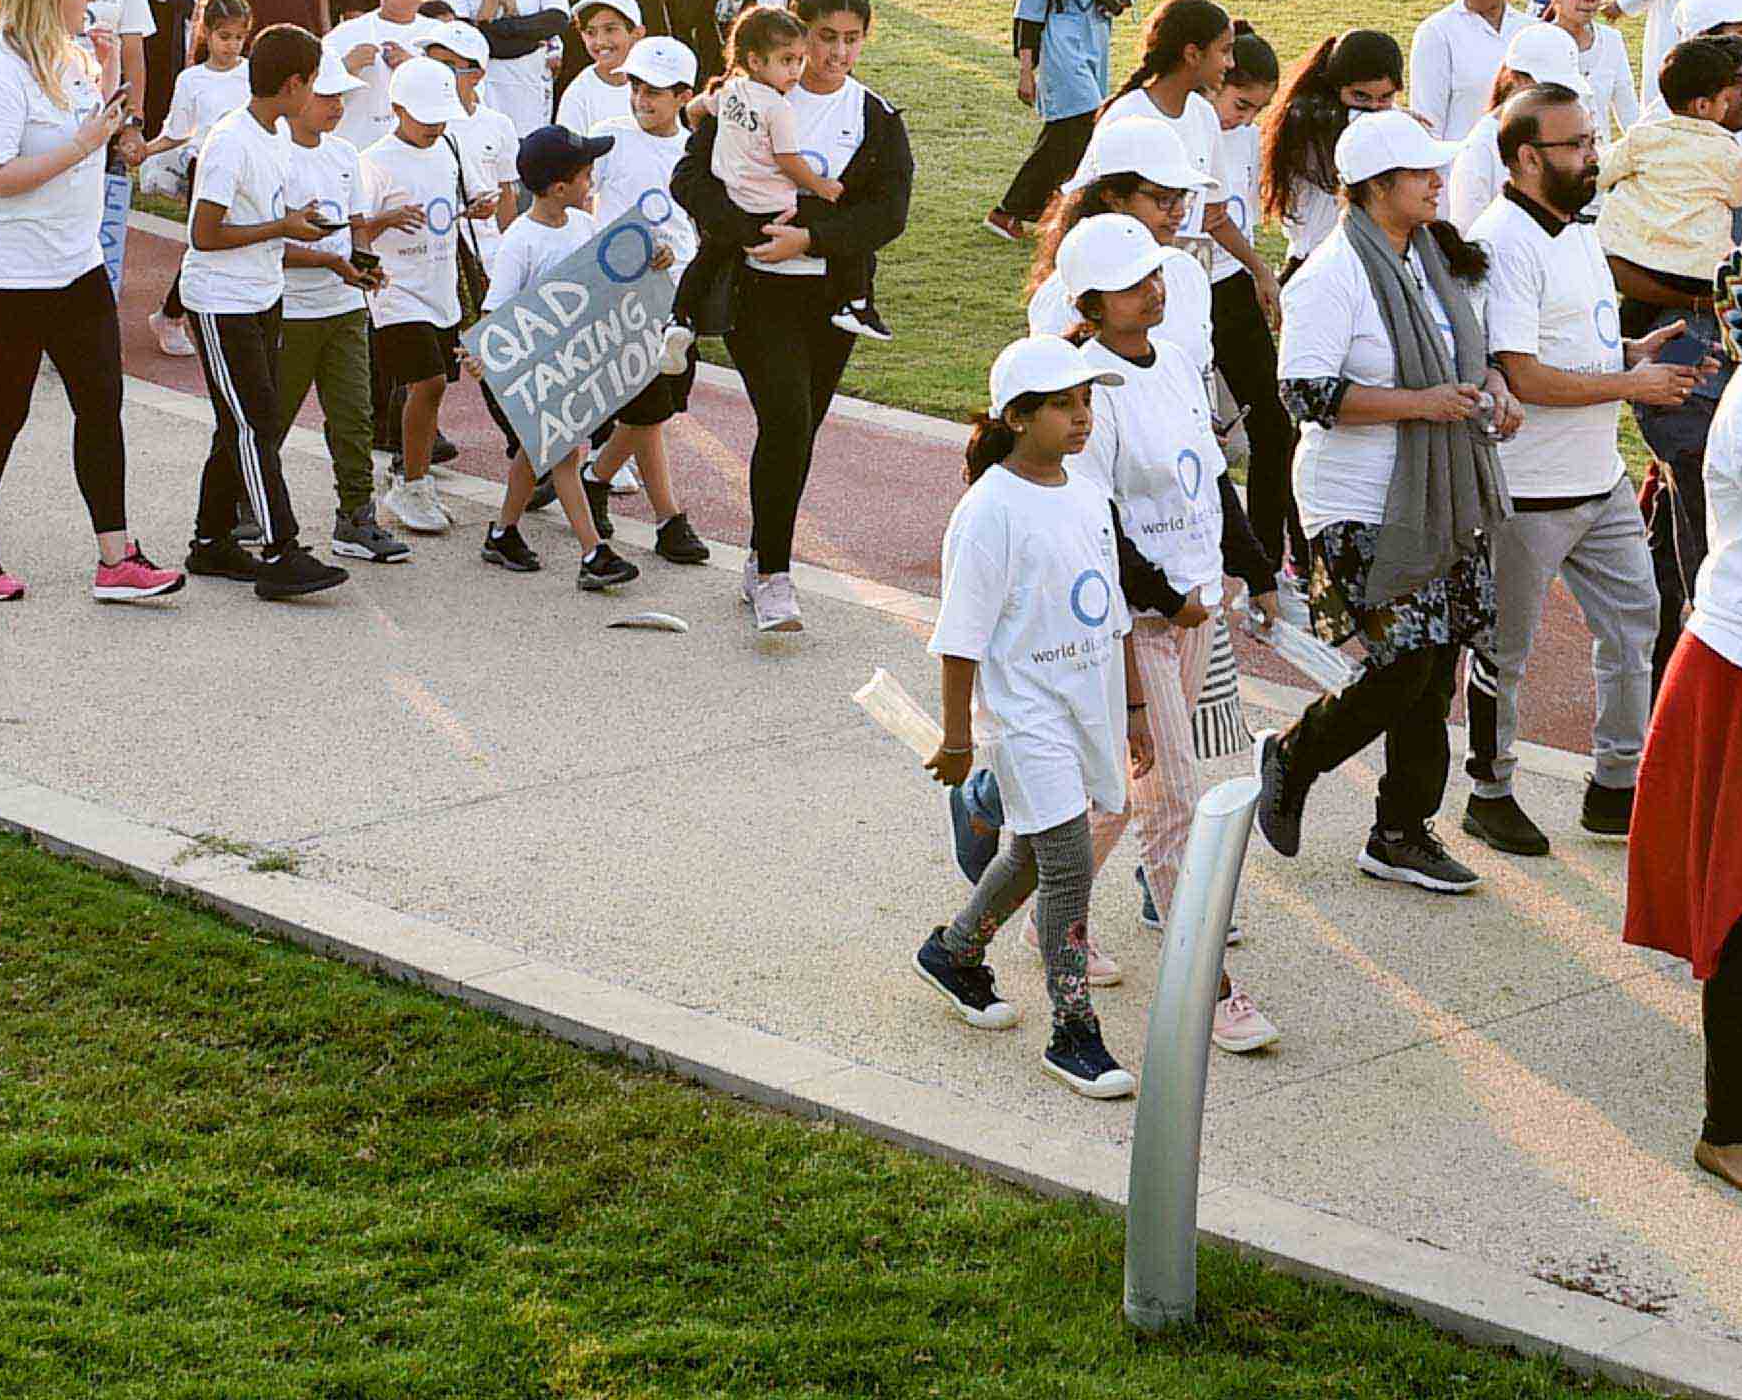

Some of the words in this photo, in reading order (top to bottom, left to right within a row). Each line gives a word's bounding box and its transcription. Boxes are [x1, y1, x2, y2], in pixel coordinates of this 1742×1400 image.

[480, 281, 590, 373] QAD
[503, 291, 647, 416] TAKING
[1141, 516, 1185, 535] world
[1031, 641, 1076, 664] world
